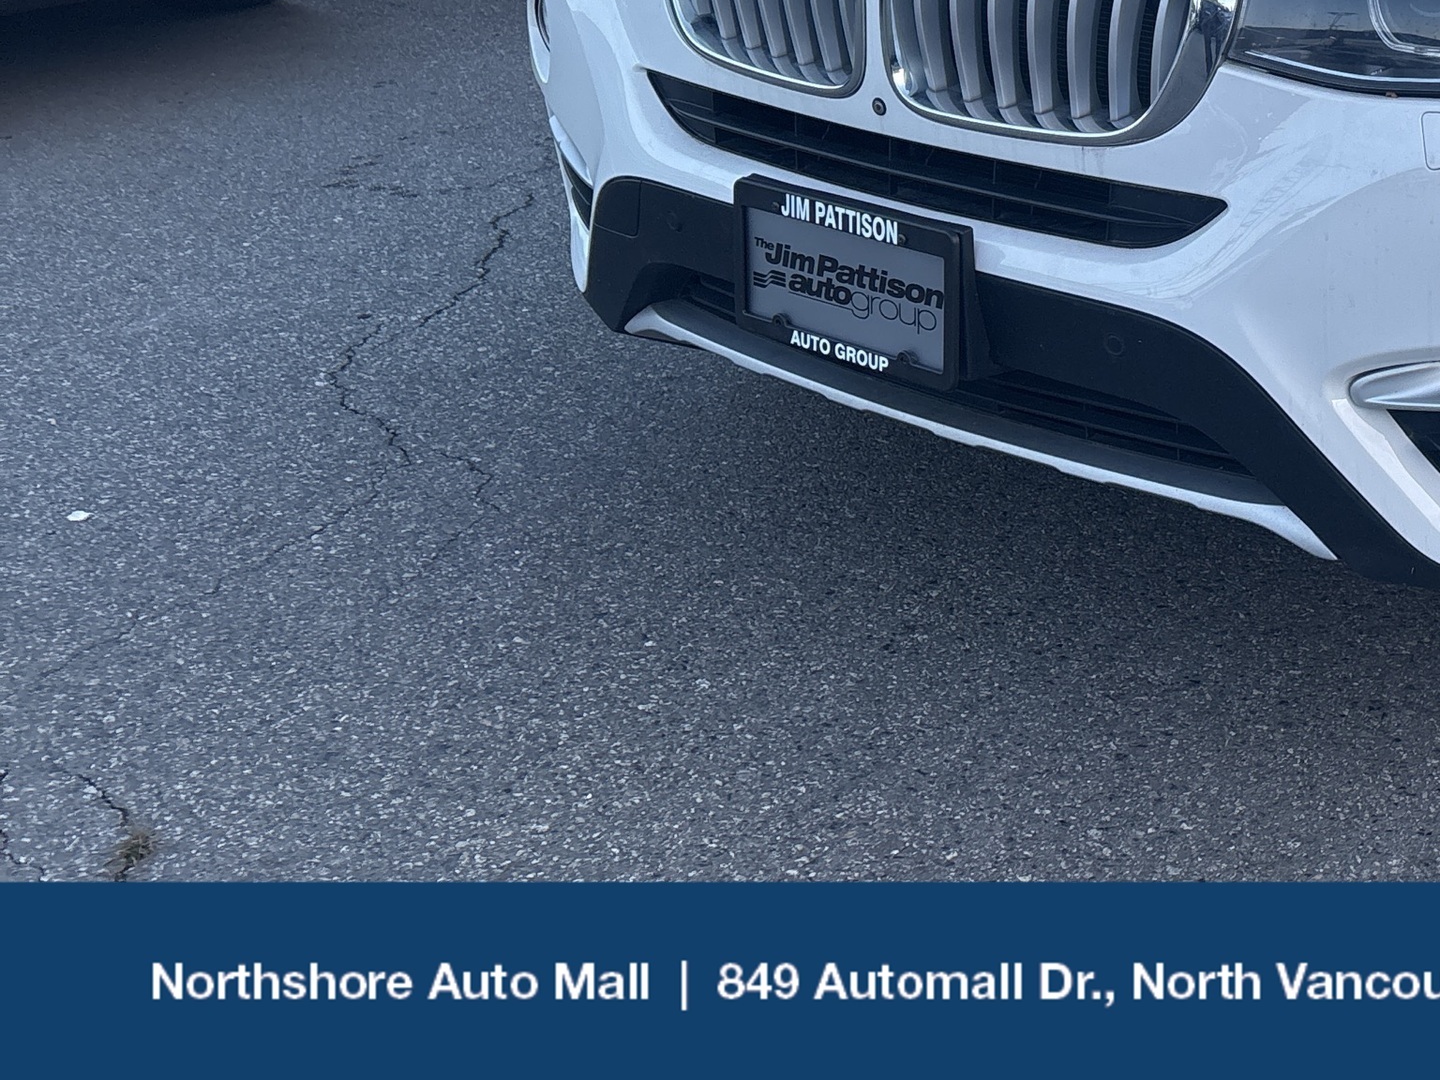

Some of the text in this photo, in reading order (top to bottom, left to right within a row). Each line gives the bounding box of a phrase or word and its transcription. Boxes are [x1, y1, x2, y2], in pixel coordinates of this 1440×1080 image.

[780, 193, 899, 246] JIM PATTISON
[754, 236, 944, 310] The Jim Pattison
[790, 330, 889, 372] AUTO GROUP
